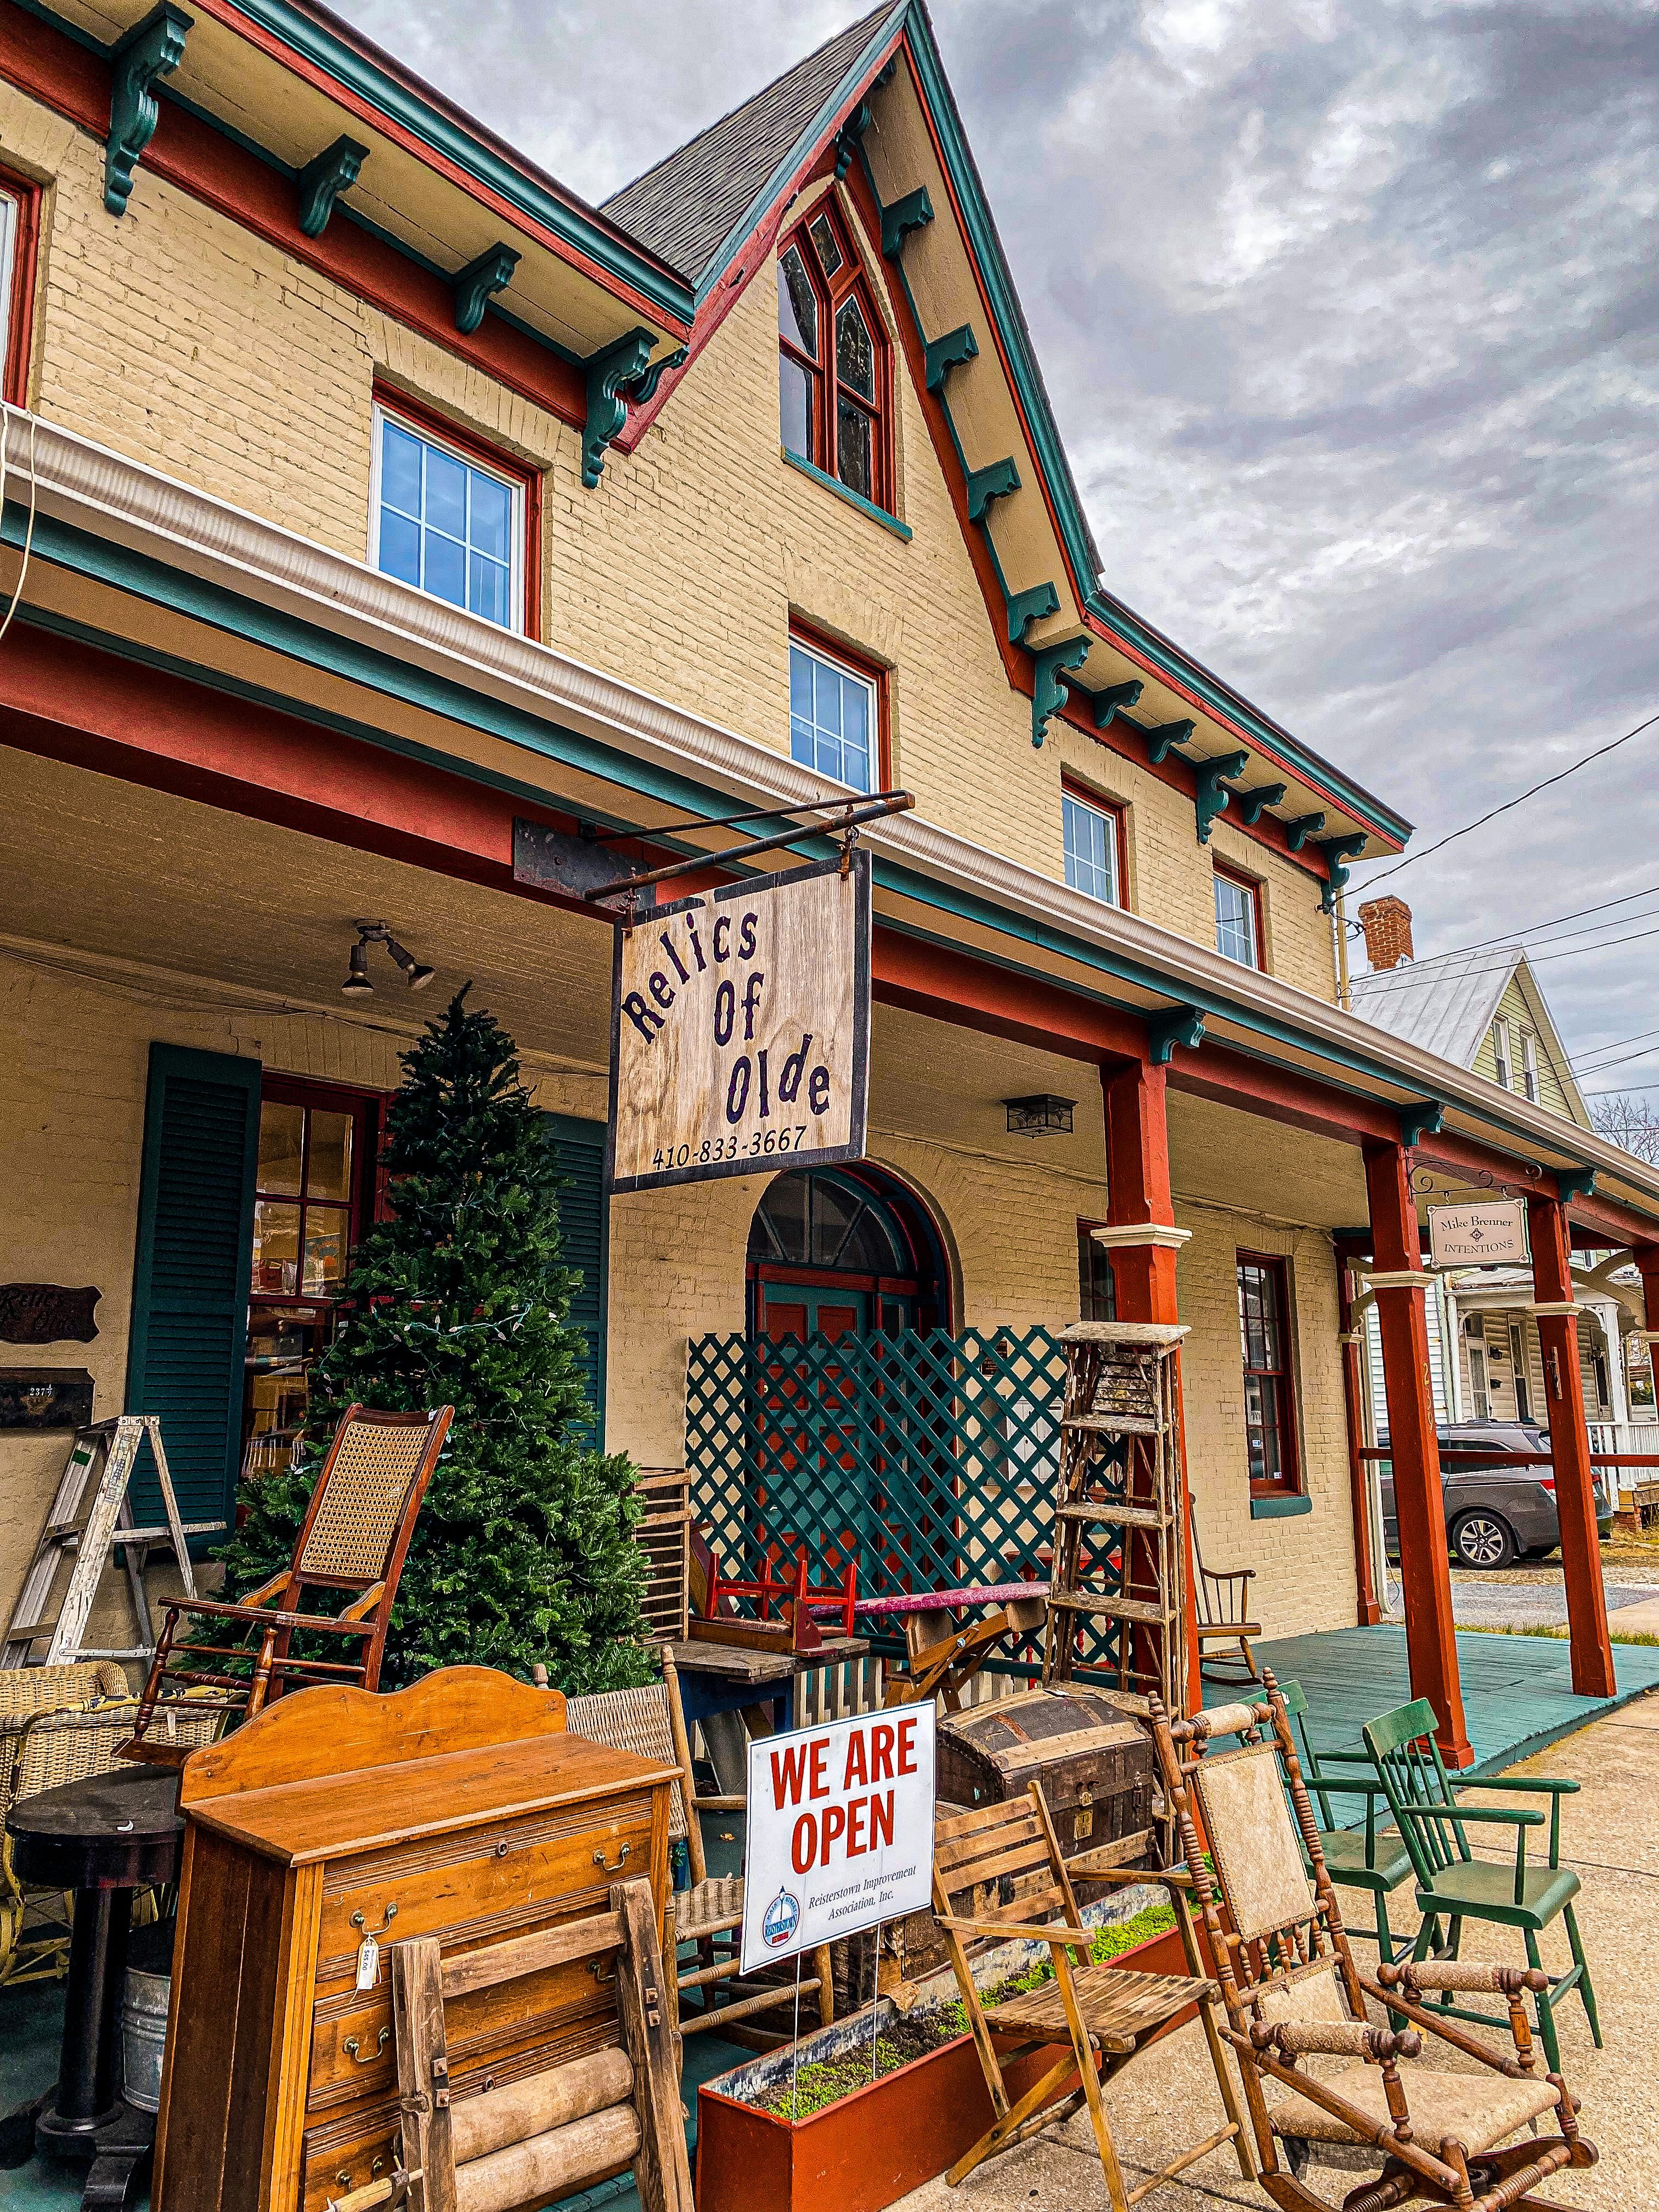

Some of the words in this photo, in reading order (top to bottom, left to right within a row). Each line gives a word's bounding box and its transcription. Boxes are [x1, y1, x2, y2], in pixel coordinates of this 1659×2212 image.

[621, 912, 758, 1045] Relics
[714, 972, 765, 1047] Of
[726, 1033, 830, 1124] Olde
[653, 1125, 807, 1170] 410-833-3667
[1440, 1216, 1469, 1232] Mike
[1471, 1215, 1514, 1227] Brenner
[1443, 1239, 1514, 1254] INTENTIONS
[770, 1737, 830, 1811] WE
[843, 1717, 917, 1791] ARE
[791, 1790, 894, 1875] OPEN
[808, 1883, 861, 1909] Reisterstown
[863, 1865, 917, 1891] Improvement
[828, 1896, 876, 1920] Association,
[879, 1890, 894, 1903] Inc.
[765, 1914, 798, 1938] REISTERSTOWN
[766, 1901, 777, 1920] MAIN
